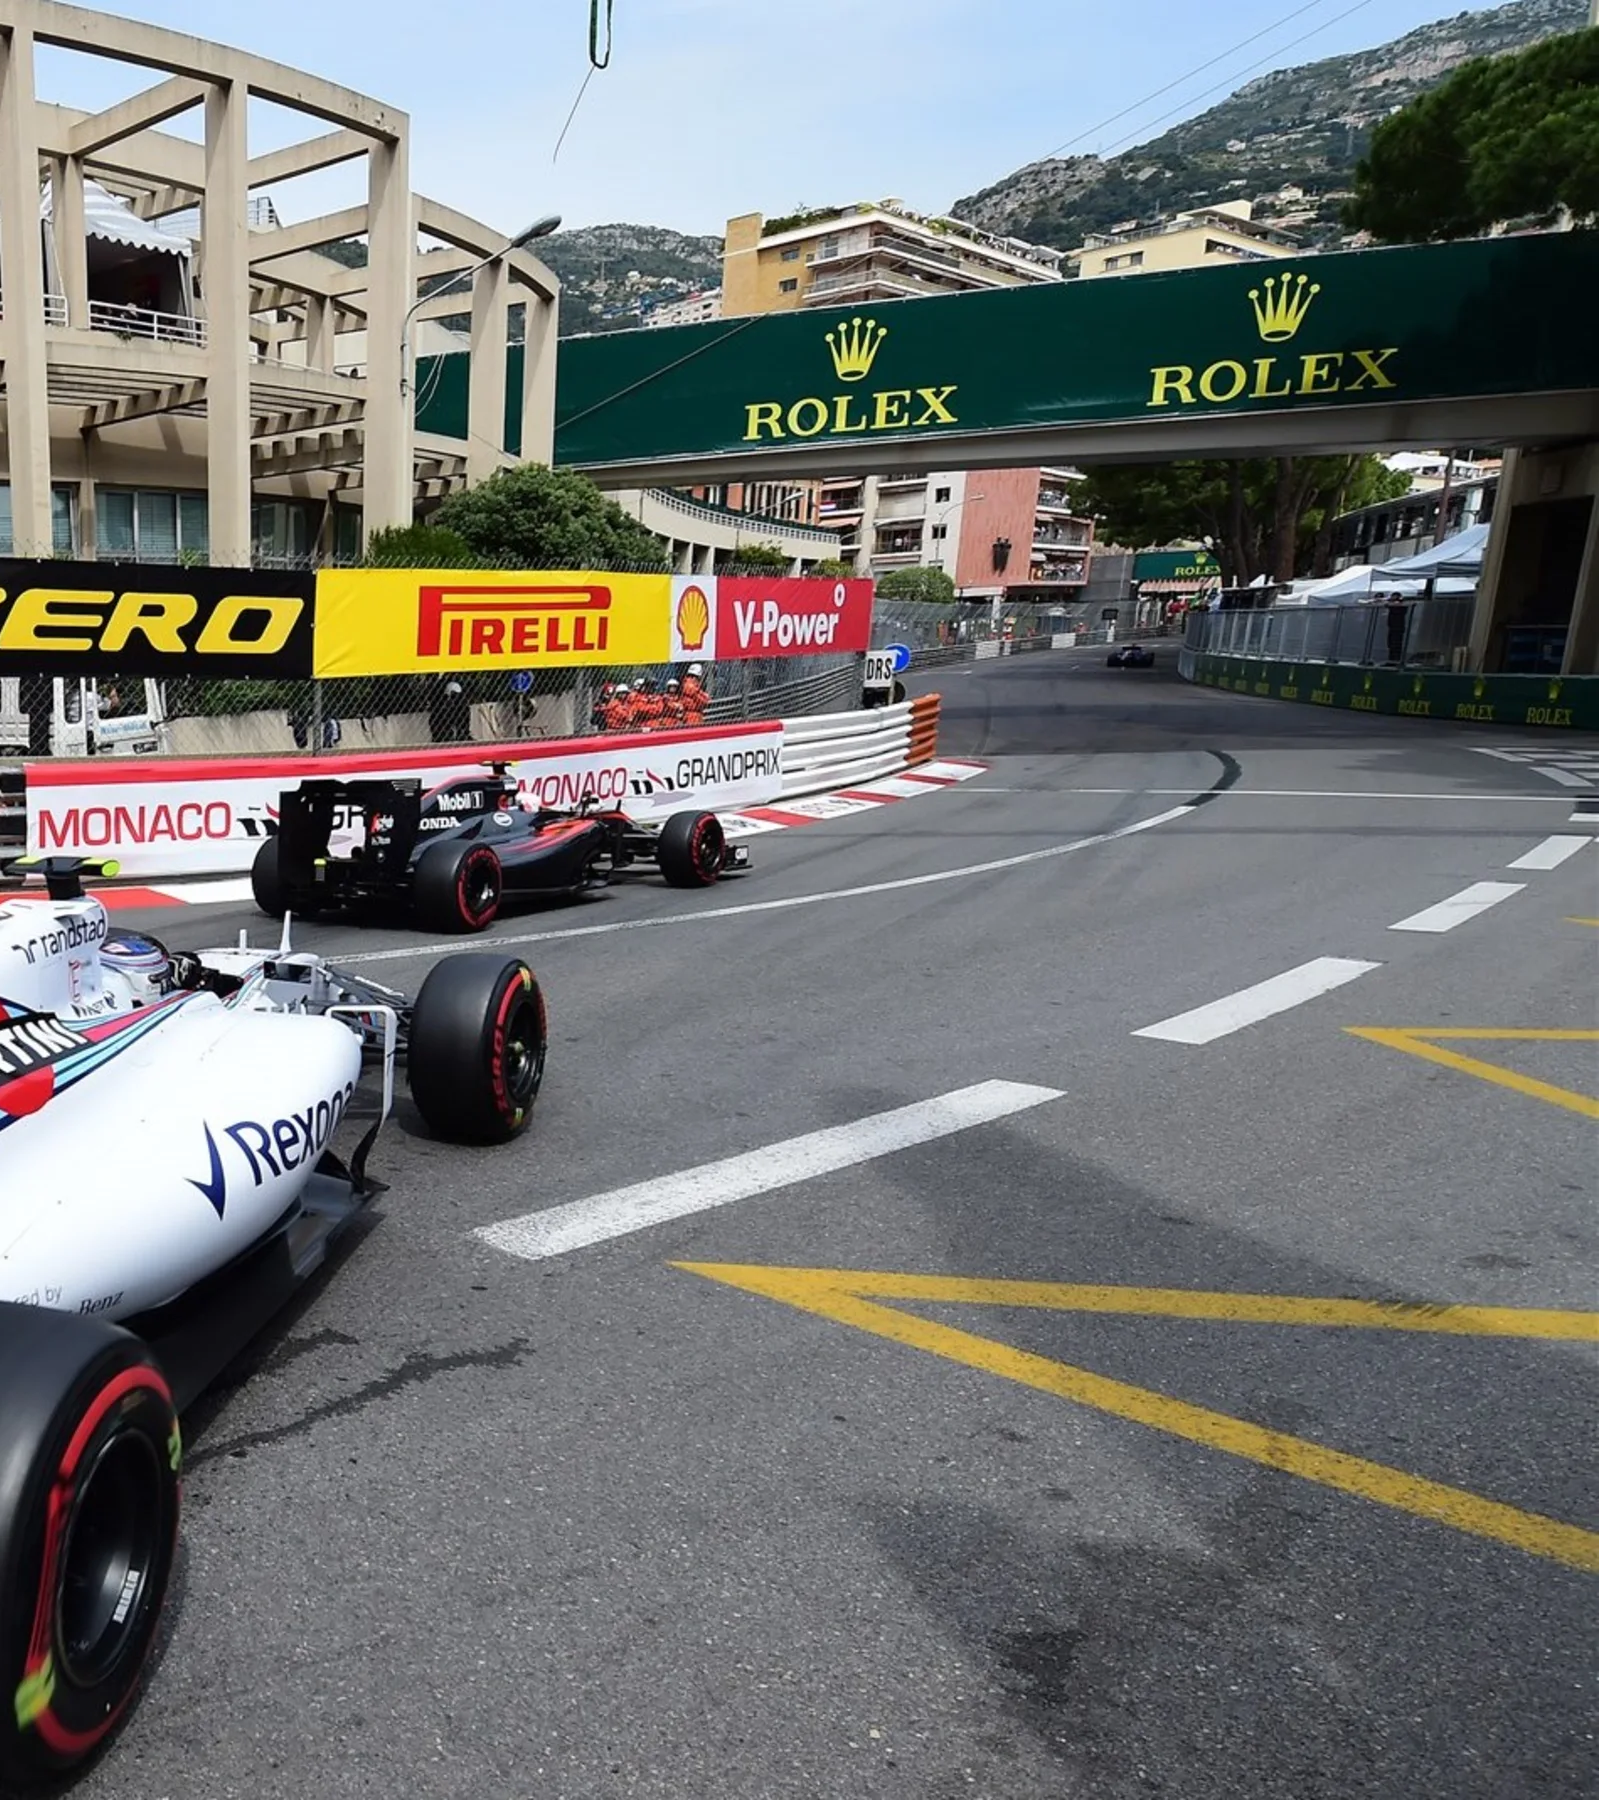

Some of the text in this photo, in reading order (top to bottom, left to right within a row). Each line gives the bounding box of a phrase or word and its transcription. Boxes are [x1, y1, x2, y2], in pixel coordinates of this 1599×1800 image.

[1147, 347, 1398, 406] ROLEX
[742, 386, 958, 441] ROLEX
[417, 585, 611, 657] PIRELLI
[733, 601, 840, 649] V-Power
[866, 658, 892, 679] DRS
[1398, 699, 1431, 716] ROLEX
[1456, 703, 1494, 721] ROLEX
[1525, 707, 1573, 726] ROLEX
[518, 747, 780, 807] MONACO GRANDPRIX
[437, 791, 470, 812] Mobil
[38, 802, 231, 849] MONACO
[40, 908, 106, 957] randstad
